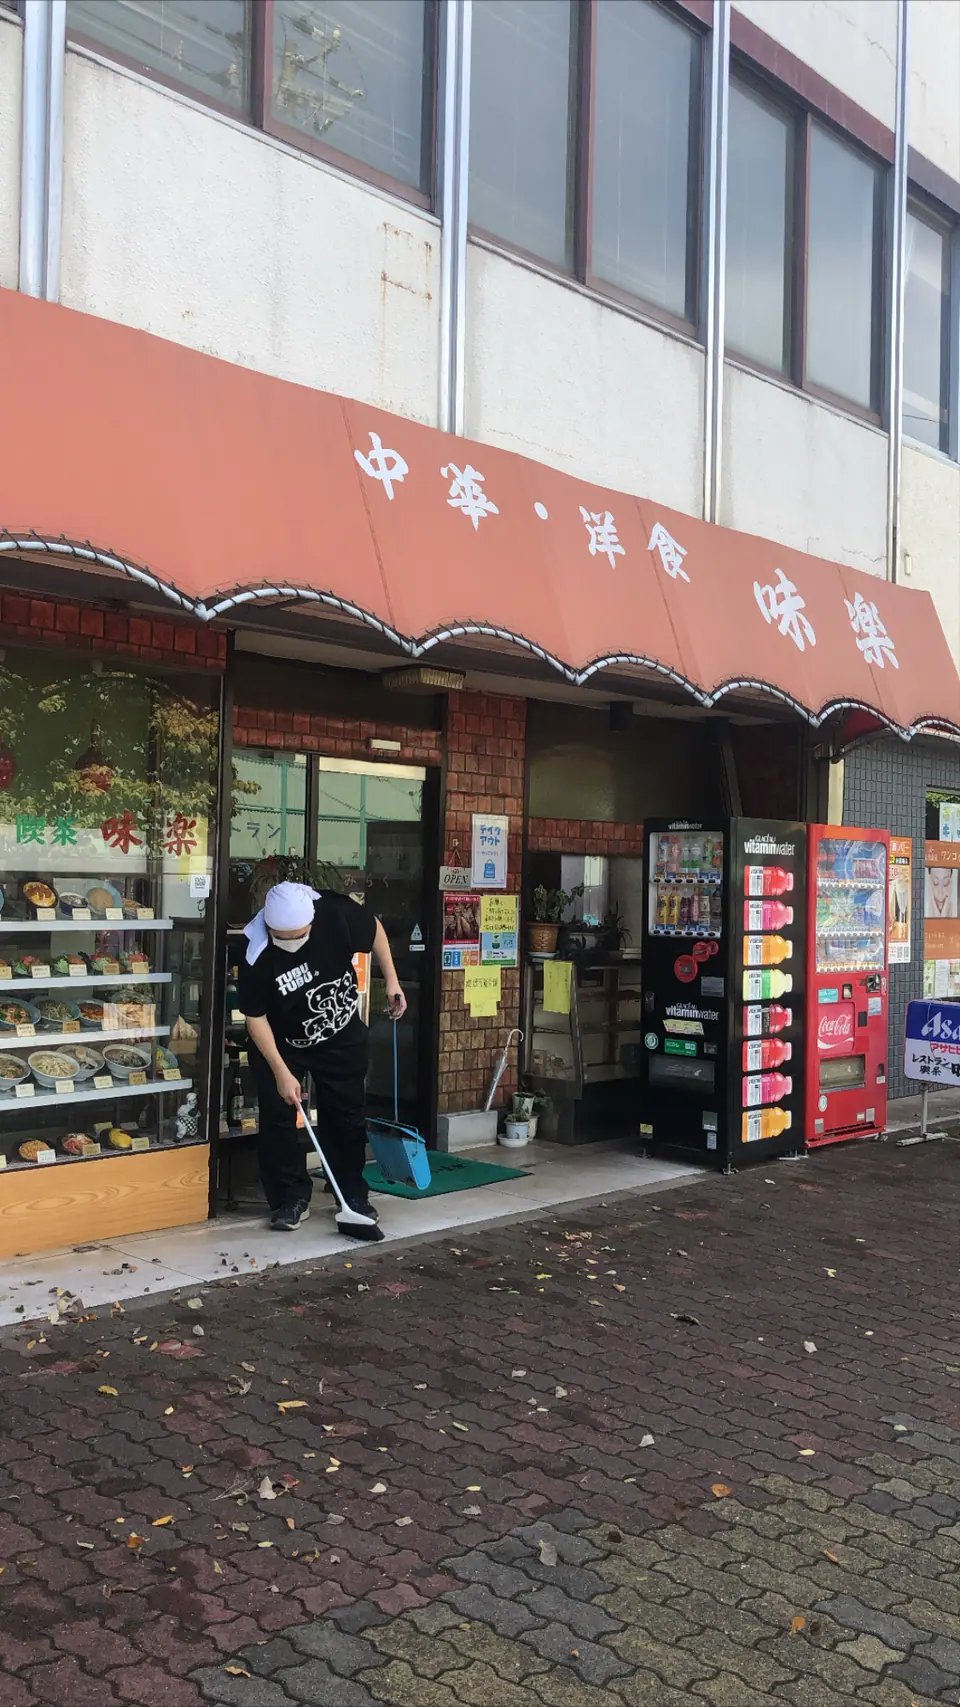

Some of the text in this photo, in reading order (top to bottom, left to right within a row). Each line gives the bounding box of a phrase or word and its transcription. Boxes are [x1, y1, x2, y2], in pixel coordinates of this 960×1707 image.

[354, 431, 690, 583] 中華・洋食
[16, 808, 198, 857] 喫茶 味楽
[480, 824, 502, 835] テイク
[480, 836, 500, 846] アウト
[744, 839, 795, 855] vitaminwater
[444, 874, 468, 884] OPEN
[275, 962, 309, 988] TUBU
[278, 971, 313, 996] TUBU
[665, 1005, 720, 1020] vitaminwater
[912, 1053, 950, 1066] レストラン
